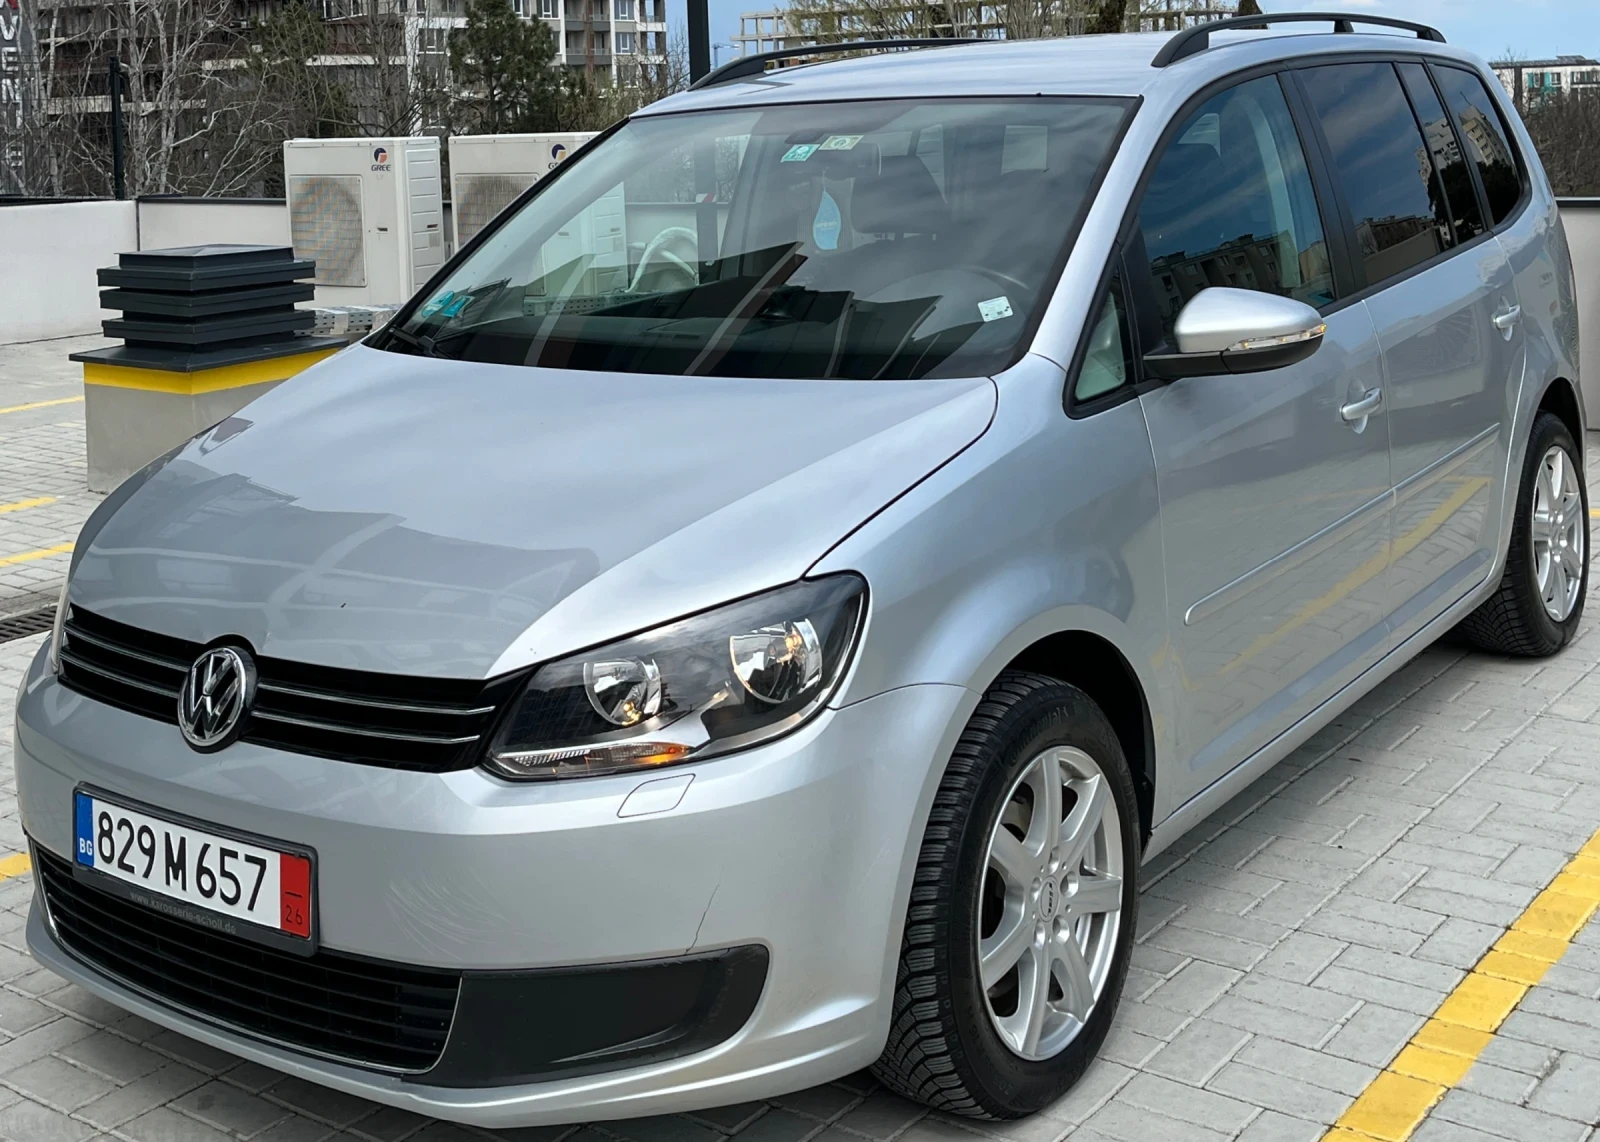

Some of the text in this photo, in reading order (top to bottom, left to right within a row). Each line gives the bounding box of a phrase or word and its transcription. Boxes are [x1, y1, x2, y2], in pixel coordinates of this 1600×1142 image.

[371, 164, 391, 172] GREE
[79, 837, 93, 856] BG
[98, 811, 267, 912] 829 M 657
[285, 904, 303, 926] 26
